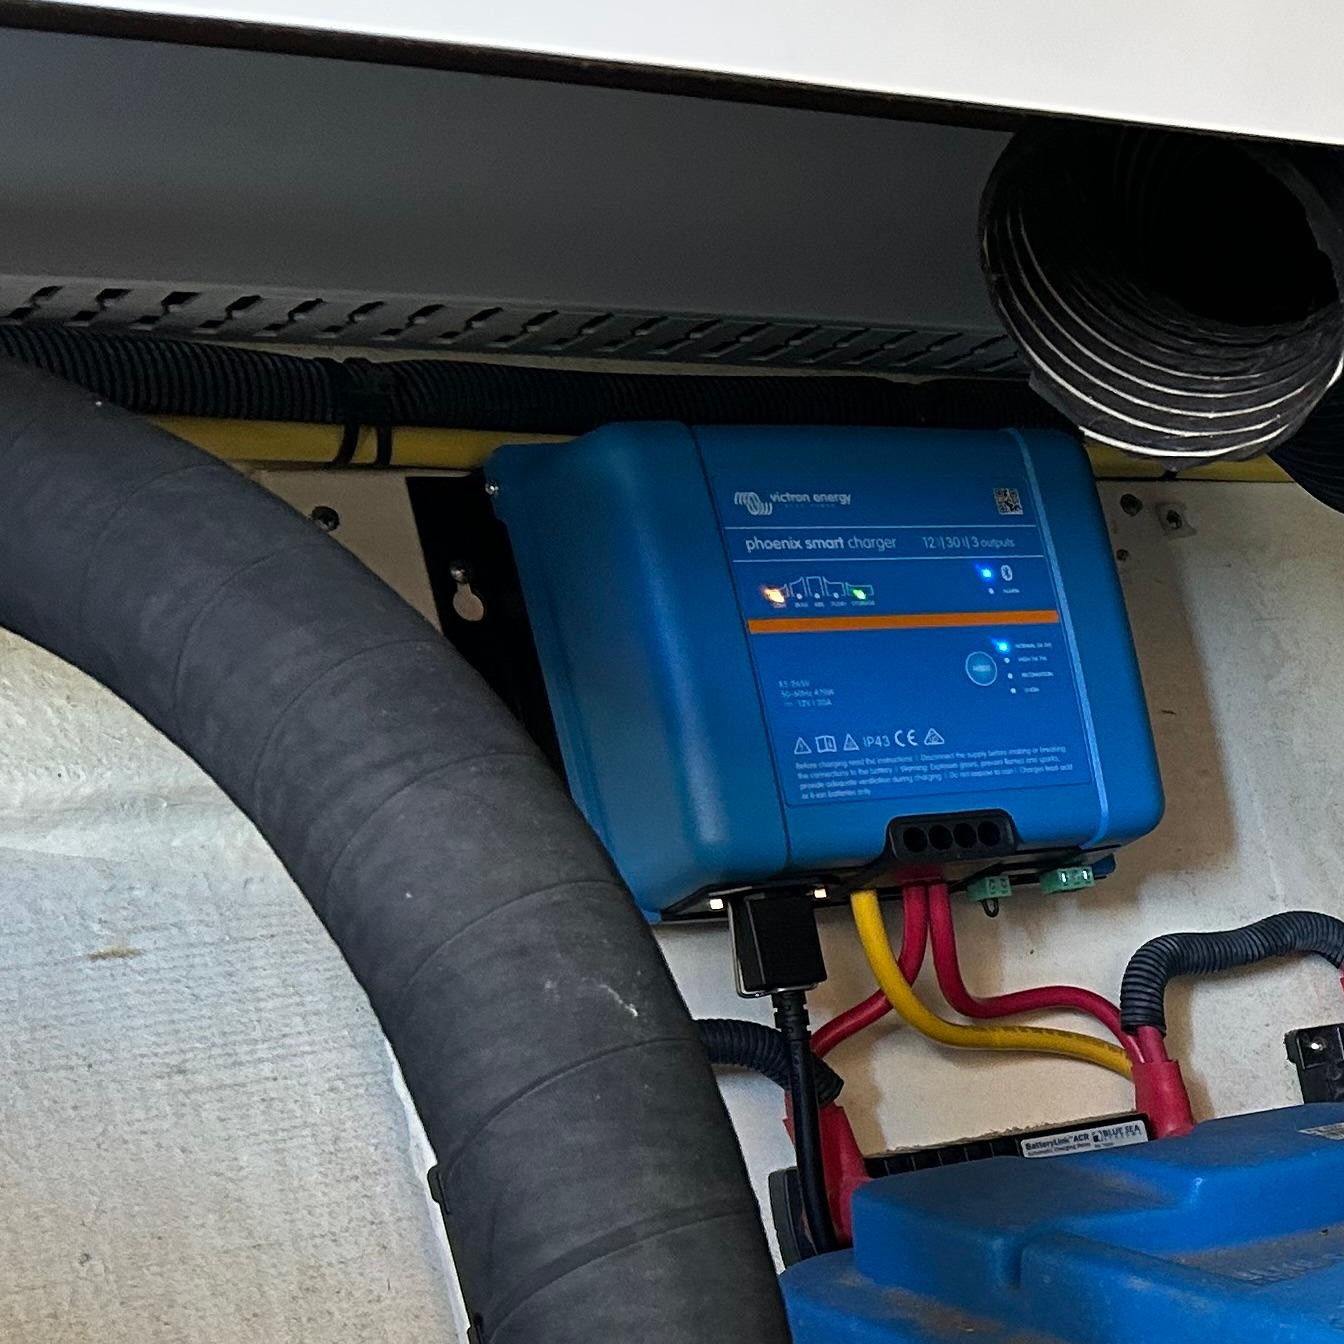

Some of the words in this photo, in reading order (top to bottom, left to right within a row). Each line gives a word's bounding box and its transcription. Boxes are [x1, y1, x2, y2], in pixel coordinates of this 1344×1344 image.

[770, 491, 811, 503] victron
[813, 493, 852, 505] energy
[745, 536, 802, 553] phoenix
[805, 536, 844, 550] smart
[848, 535, 897, 552] charger
[980, 537, 1016, 549] outputs
[863, 735, 891, 747] IP43
[1073, 1133, 1089, 1142] ACR
